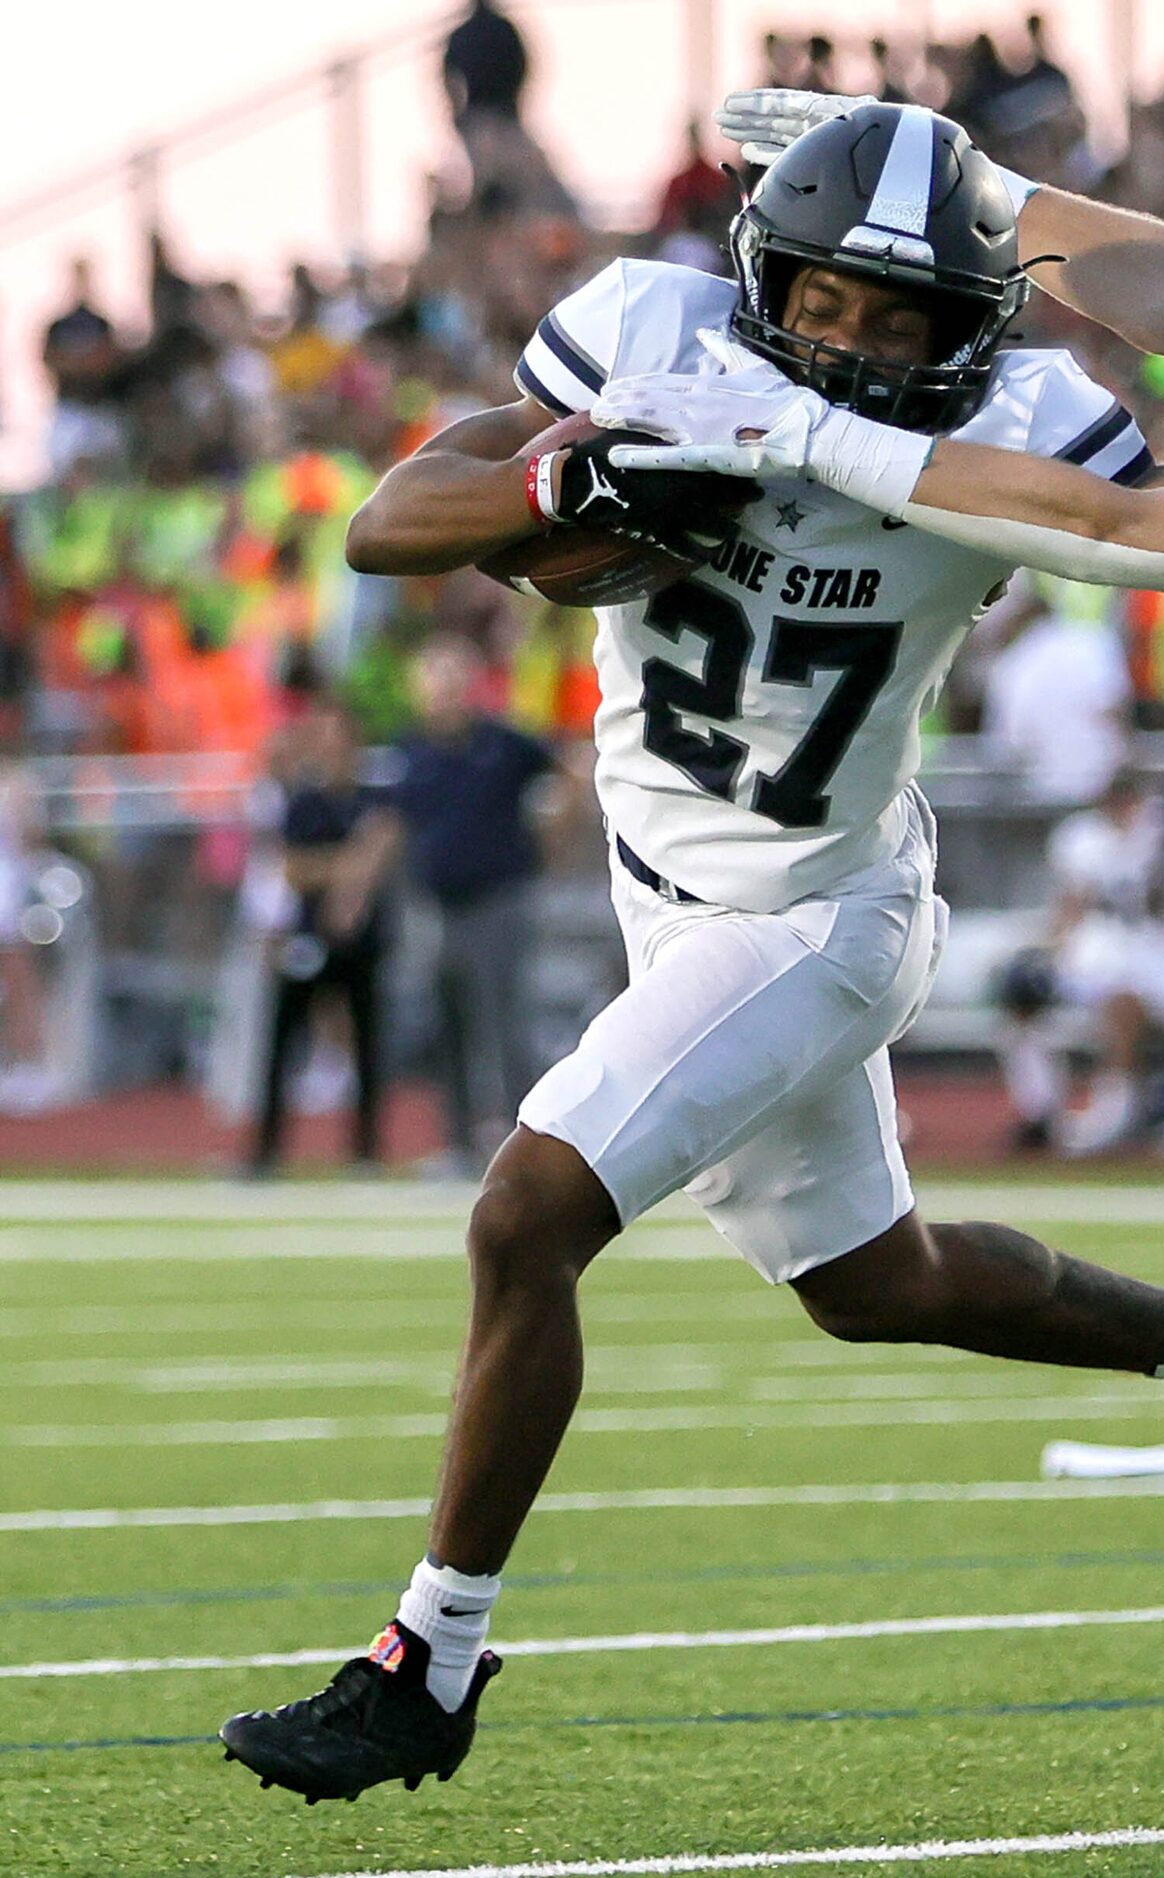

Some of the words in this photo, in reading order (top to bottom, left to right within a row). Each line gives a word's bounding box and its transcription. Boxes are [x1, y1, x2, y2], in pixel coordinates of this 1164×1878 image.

[709, 538, 776, 594] ONE
[779, 564, 882, 609] STAR
[641, 578, 905, 829] 27
